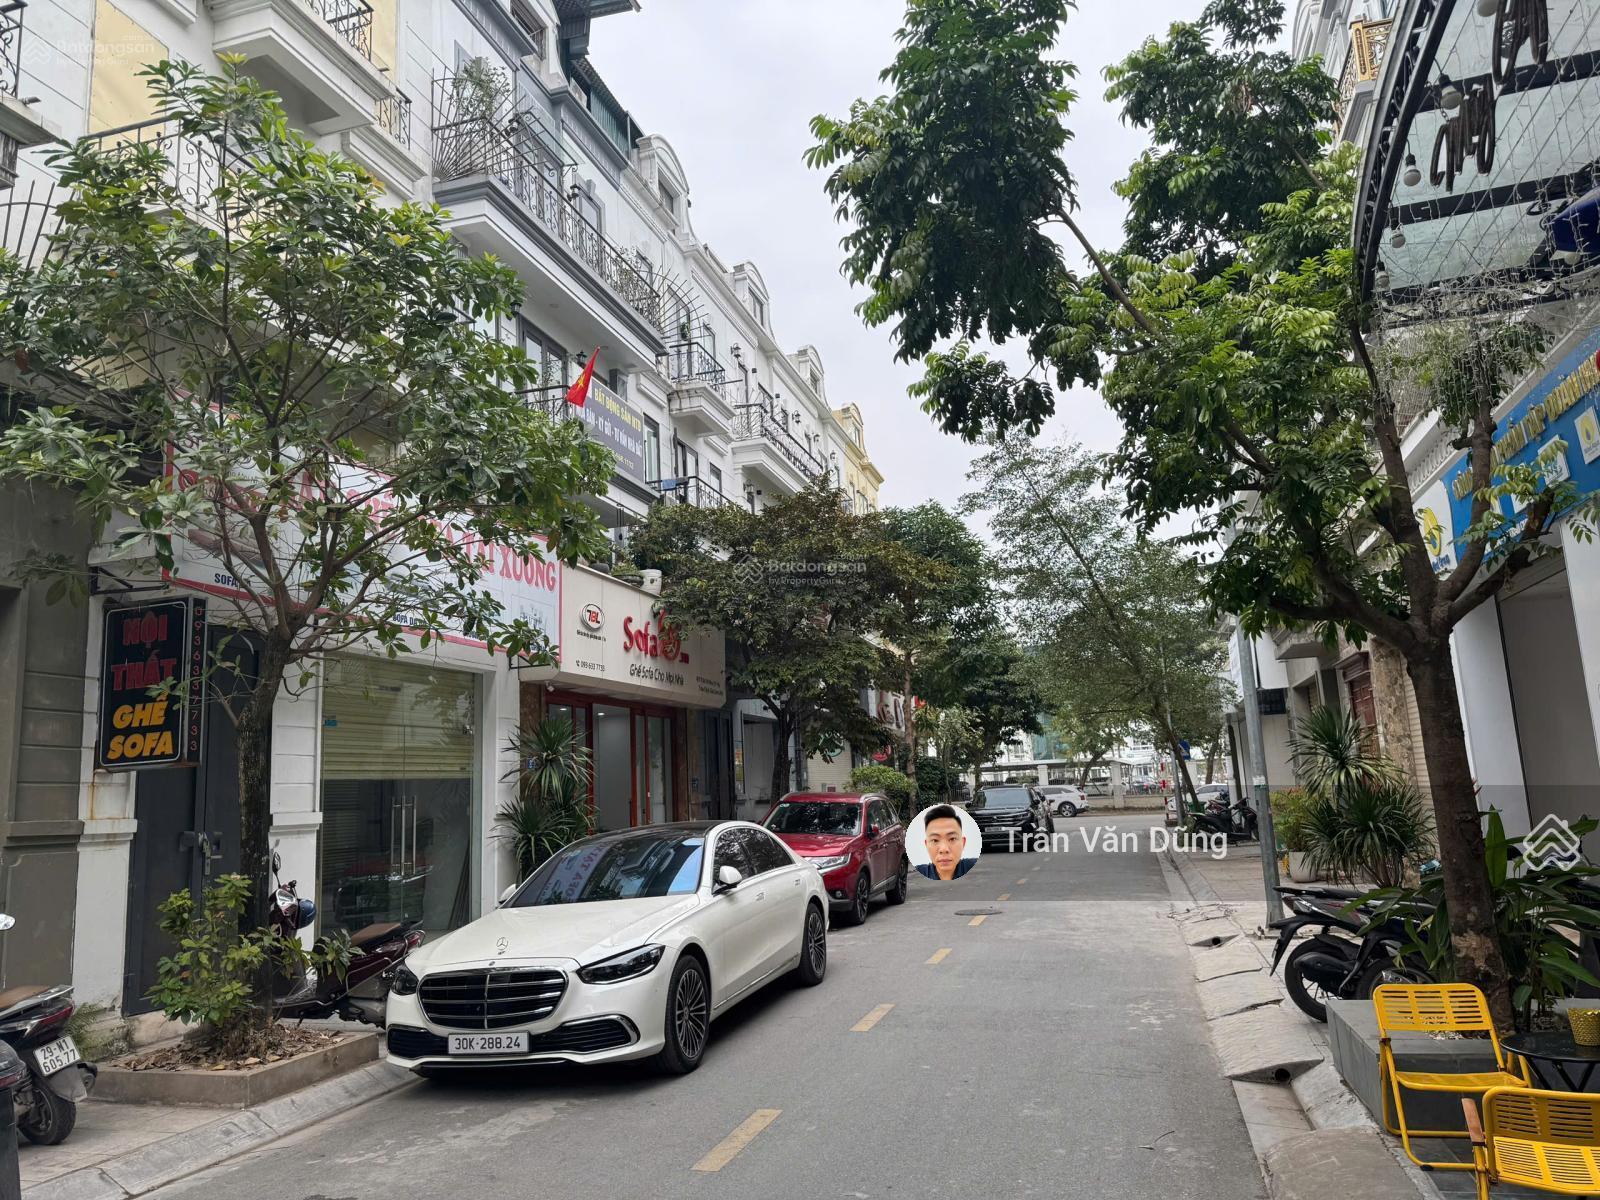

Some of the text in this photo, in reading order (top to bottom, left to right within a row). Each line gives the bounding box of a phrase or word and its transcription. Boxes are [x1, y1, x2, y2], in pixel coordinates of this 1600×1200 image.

[122, 611, 168, 649] NỘI
[112, 650, 177, 690] THẤT
[629, 663, 642, 678] Ghế
[641, 665, 654, 680] Sofa
[654, 668, 665, 681] Cho
[112, 690, 169, 730] GHẾ
[107, 730, 174, 760] SOFA
[43, 1048, 76, 1072] 605.77
